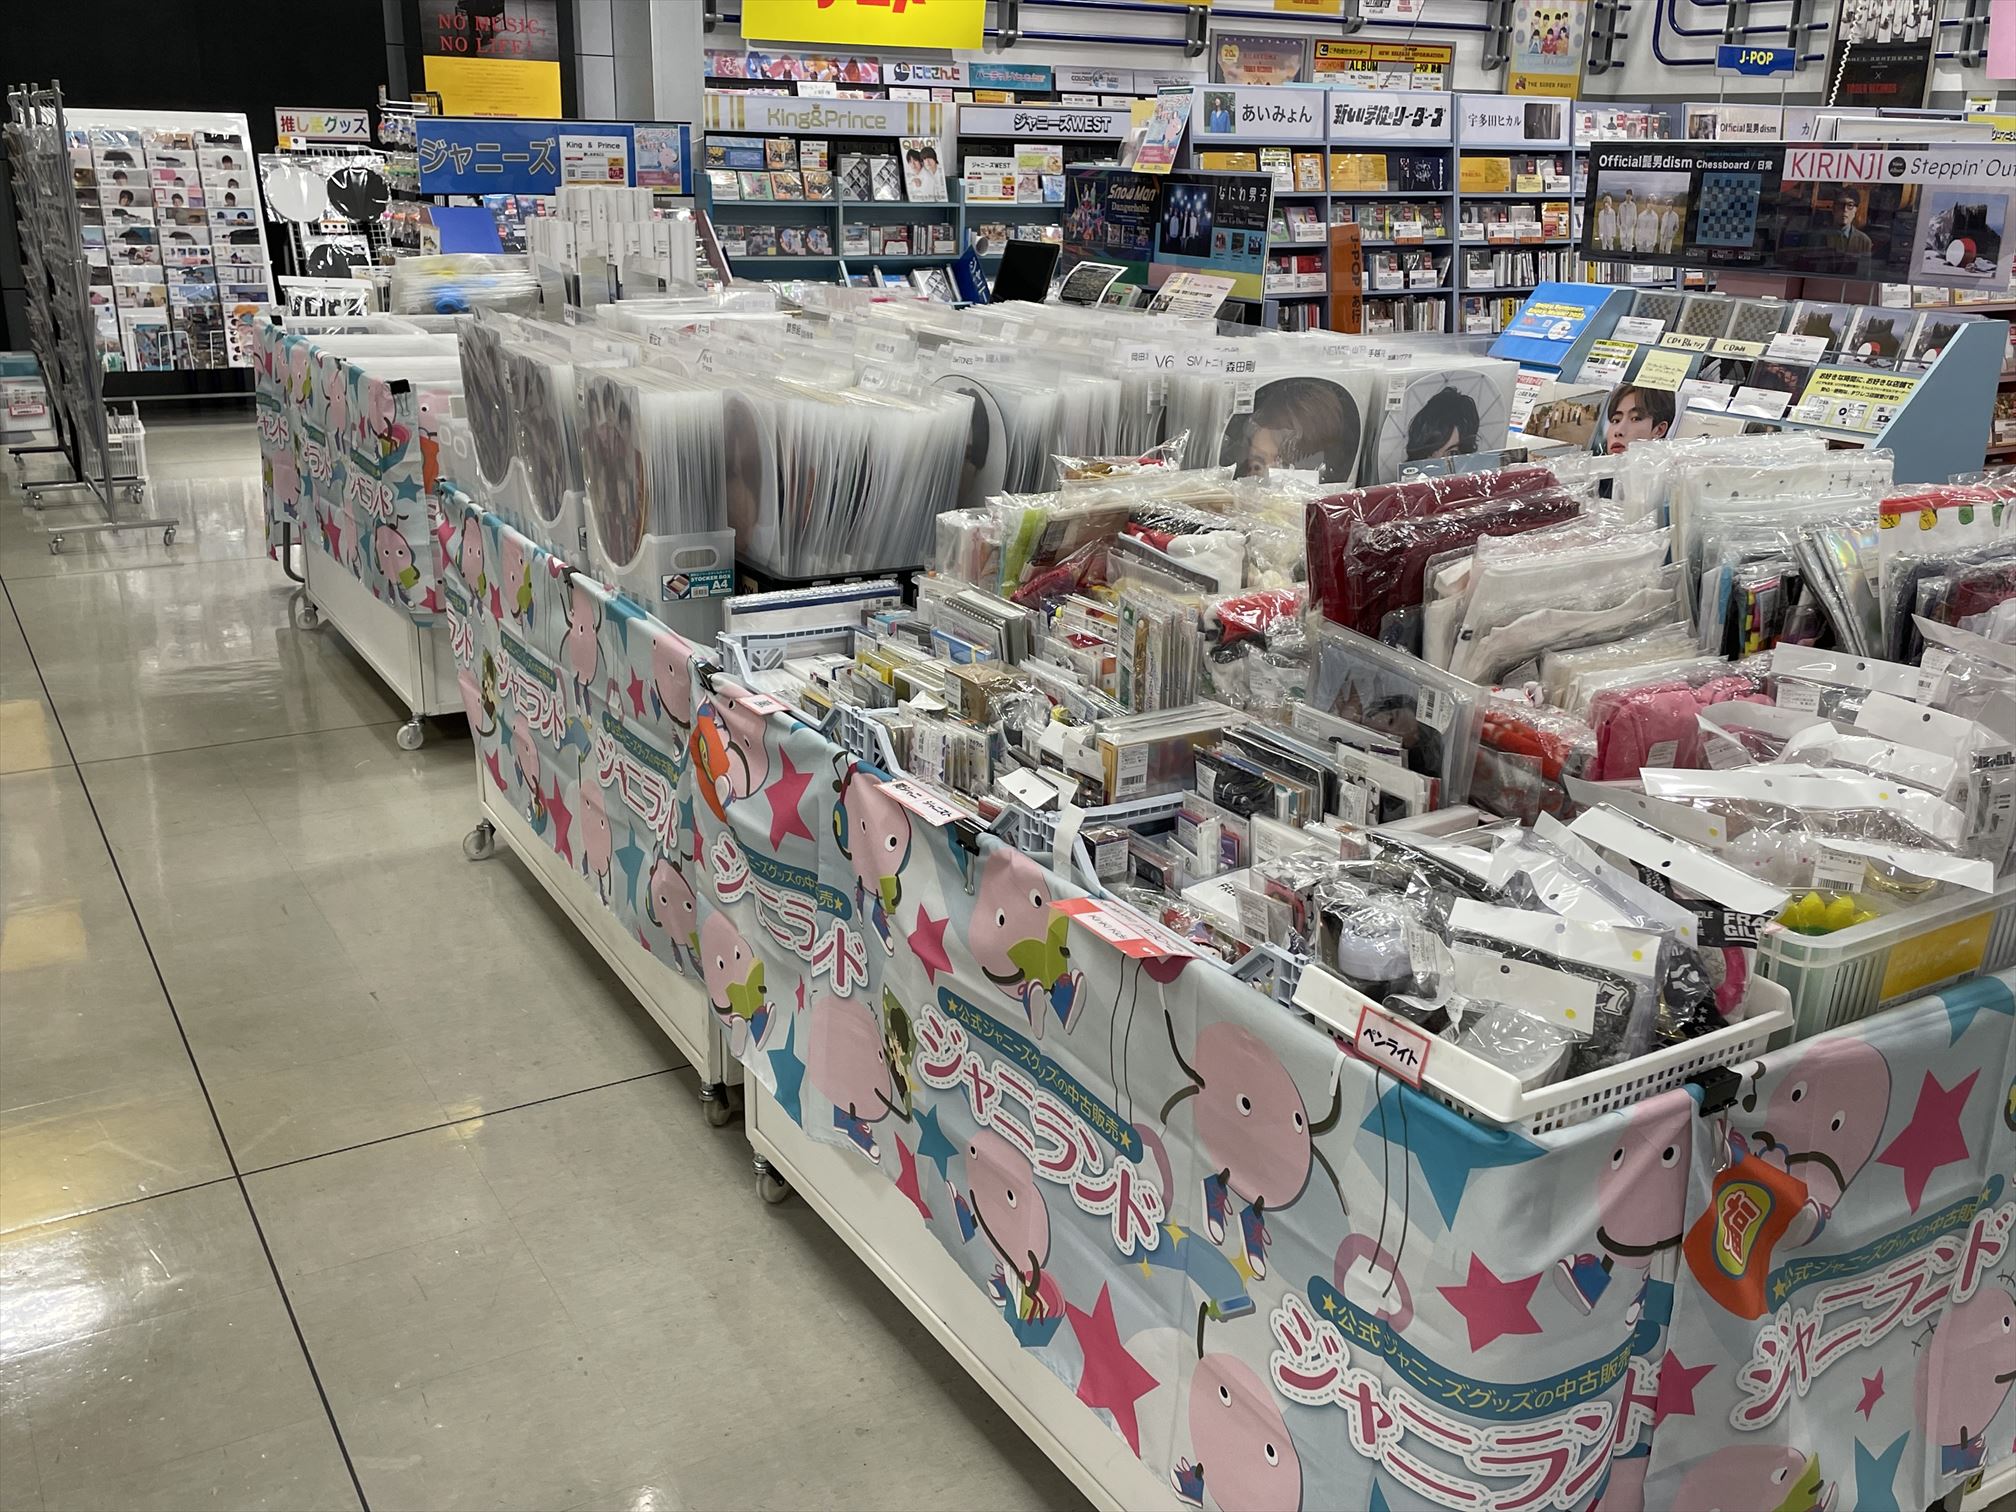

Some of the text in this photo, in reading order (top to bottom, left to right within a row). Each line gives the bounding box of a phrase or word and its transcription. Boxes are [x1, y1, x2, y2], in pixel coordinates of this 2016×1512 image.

[438, 14, 547, 36] NO MUSIC,
[440, 35, 534, 55] NO LIFE!
[1349, 60, 1379, 72] ALBUM
[1739, 50, 1774, 66] J-POP
[912, 65, 960, 80] にじさんじ
[767, 107, 887, 130] King&Prince
[1013, 113, 1112, 134] ジャニーズWEST
[1242, 105, 1313, 124] あいみょん
[1467, 112, 1522, 128] 宇多田ヒカル
[280, 114, 369, 136] 推し活グッズ
[566, 141, 583, 151] King
[597, 141, 621, 150] Prince
[419, 137, 558, 176] ジャニーズ
[1598, 153, 1693, 170] Official髭男dism
[1695, 159, 1750, 171] Chessboard
[1757, 160, 1773, 171] 日常
[1791, 151, 1885, 180] KIRINJI
[1911, 158, 1983, 178] Steppin'
[1107, 183, 1157, 201] Snow Man
[1218, 186, 1268, 203] なにわ男子
[1351, 235, 1361, 287] J-POP
[1154, 355, 1175, 369] V6
[1225, 360, 1256, 373] 森田剛
[690, 575, 718, 583] STOCKER
[712, 580, 729, 590] A4
[1363, 1027, 1418, 1066] ペンライト
[957, 1004, 1122, 1144] 公式ジャニーズグッズの中古販売
[914, 1003, 1165, 1257] ジャニランド
[1729, 1201, 2016, 1431] ジャニランド
